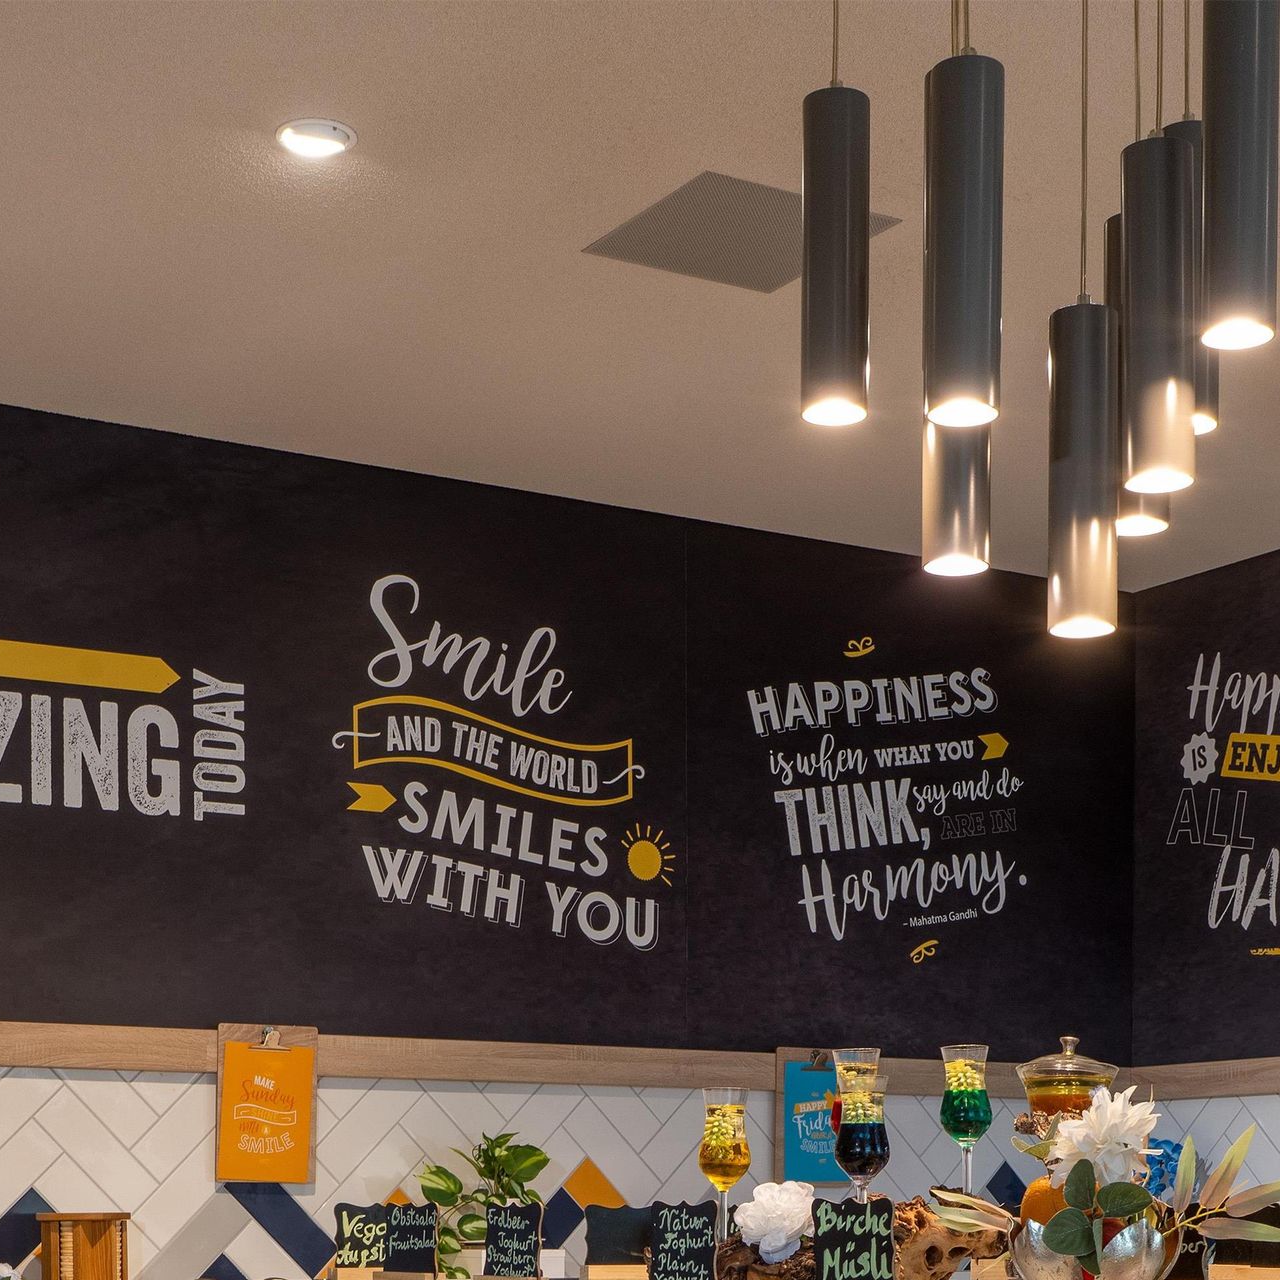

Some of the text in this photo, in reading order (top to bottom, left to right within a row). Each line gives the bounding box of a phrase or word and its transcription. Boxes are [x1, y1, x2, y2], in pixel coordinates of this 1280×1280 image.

[367, 574, 573, 717] Smile
[746, 667, 999, 737] HAPPINESS
[193, 668, 246, 821] TODAY
[386, 715, 598, 794] AND THE WORLD
[769, 733, 974, 785] is when WHAT YOU
[1191, 744, 1207, 772] IS
[774, 778, 931, 856] THINK,
[912, 767, 1025, 816] say and do
[397, 781, 608, 877] SMILES
[940, 808, 1017, 840] ARE IN
[1166, 788, 1255, 850] ALL
[361, 845, 660, 951] WITH YOU
[797, 850, 1028, 941] Harmony.
[909, 908, 978, 928] Mahatma Gandhi
[240, 1080, 295, 1110] Sunday
[254, 1075, 276, 1090] MAKE
[799, 1101, 828, 1112] HAPPY
[238, 1131, 294, 1154] SMILE
[792, 1111, 832, 1138] Frida
